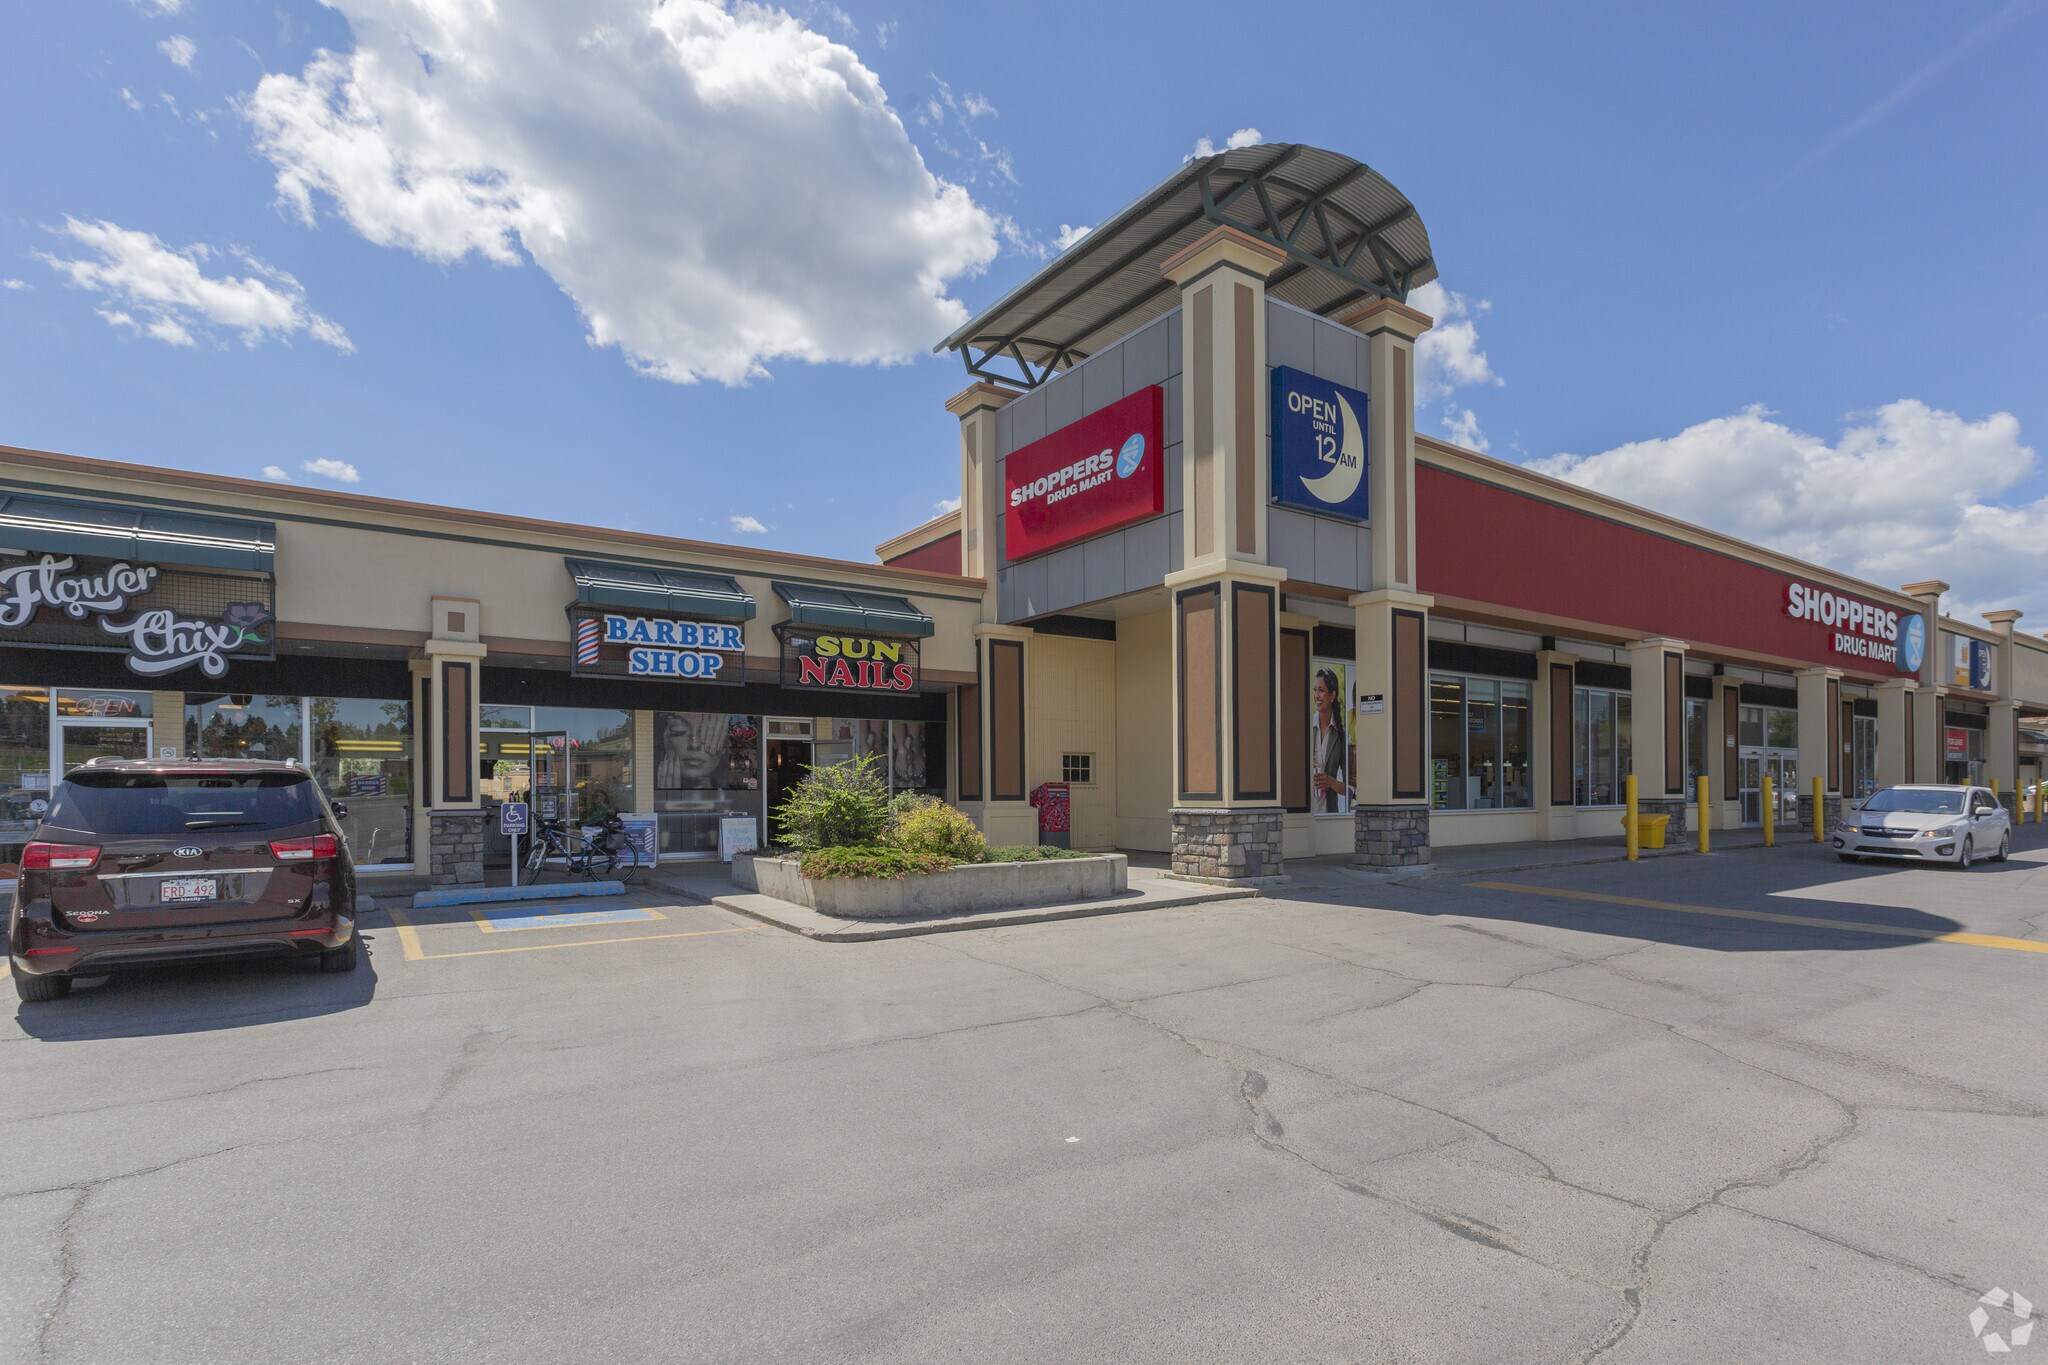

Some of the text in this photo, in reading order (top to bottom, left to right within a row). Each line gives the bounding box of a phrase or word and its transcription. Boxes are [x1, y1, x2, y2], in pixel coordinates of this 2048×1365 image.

[1288, 391, 1336, 424] OPEN
[1313, 420, 1336, 435] UNTIL
[1316, 434, 1357, 469] 12 AM
[1010, 448, 1114, 507] SHOPPERS
[1047, 468, 1113, 505] DRUG MART
[0, 554, 157, 627] Flower
[1787, 582, 1898, 641] SHOPPERS
[102, 609, 248, 677] Chix
[605, 615, 744, 650] BARBER
[814, 636, 902, 661] SUN
[1834, 632, 1898, 663] DRUG MART
[630, 650, 723, 678] SHOP
[799, 655, 914, 691] NAILS
[75, 698, 137, 713] OPEN
[179, 848, 198, 856] KIA
